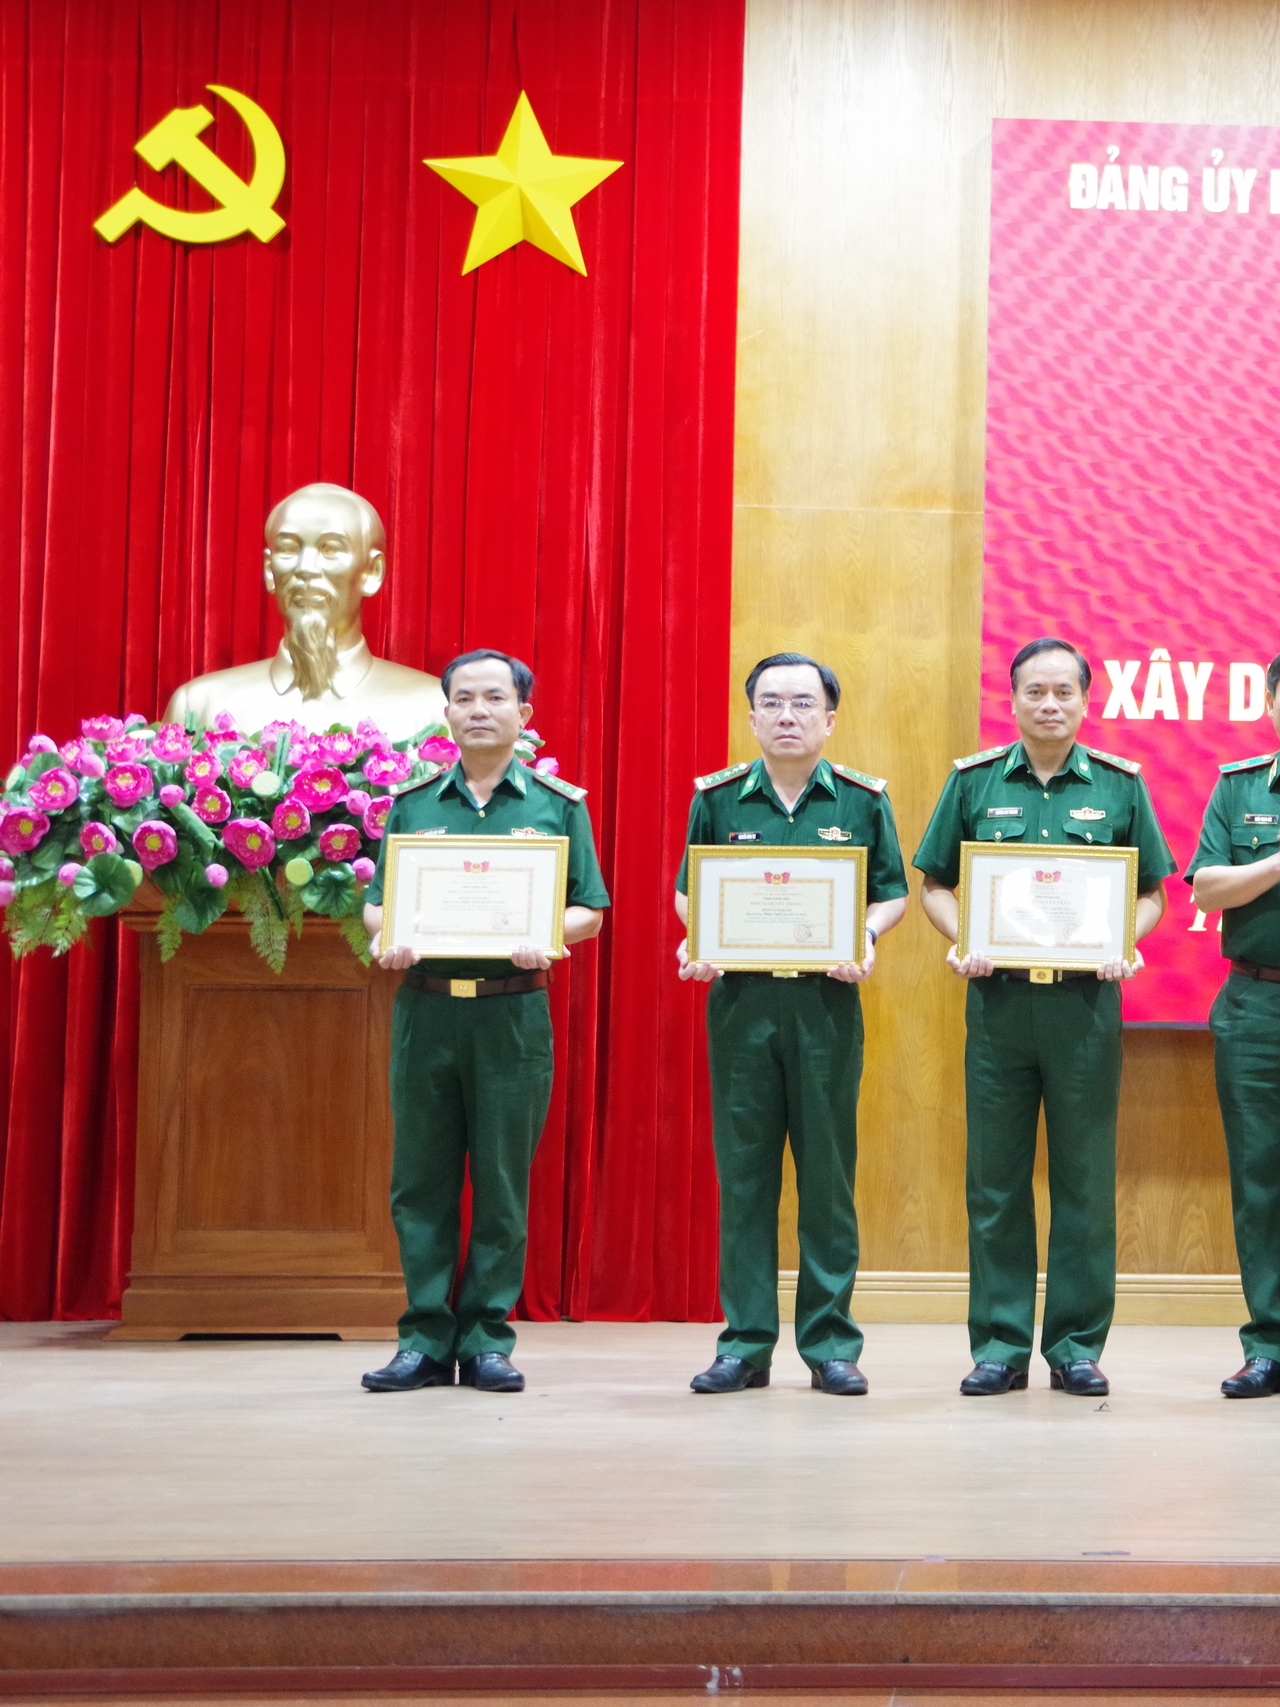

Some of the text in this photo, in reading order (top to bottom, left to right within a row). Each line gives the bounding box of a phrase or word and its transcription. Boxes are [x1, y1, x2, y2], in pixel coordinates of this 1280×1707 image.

[1068, 144, 1190, 212] ĐẢNG
[1201, 148, 1258, 214] ỦY
[1101, 647, 1215, 721] XÂY
